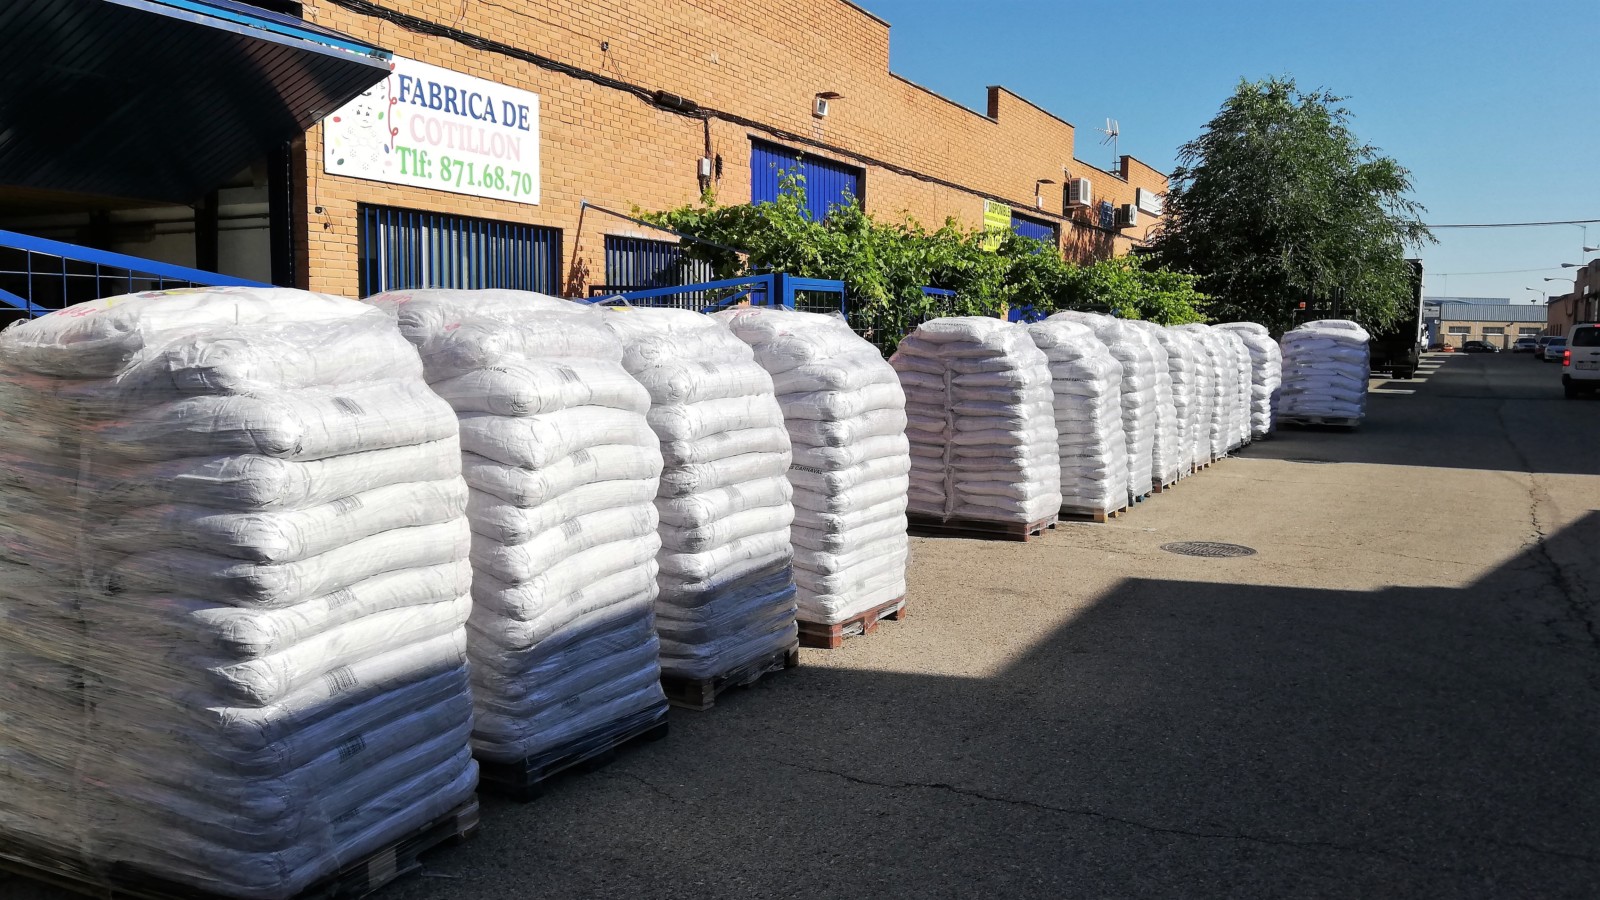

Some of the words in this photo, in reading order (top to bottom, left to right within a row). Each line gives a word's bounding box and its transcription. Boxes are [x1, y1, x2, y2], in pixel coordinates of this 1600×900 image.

[398, 74, 497, 124] FABRICA
[502, 100, 530, 131] DE
[410, 114, 521, 162] COTILLON
[396, 145, 432, 178] Tlf:
[440, 155, 532, 197] 871.68.70
[988, 202, 1010, 217] DISPONIBLE
[794, 465, 823, 475] CARNAVAL
